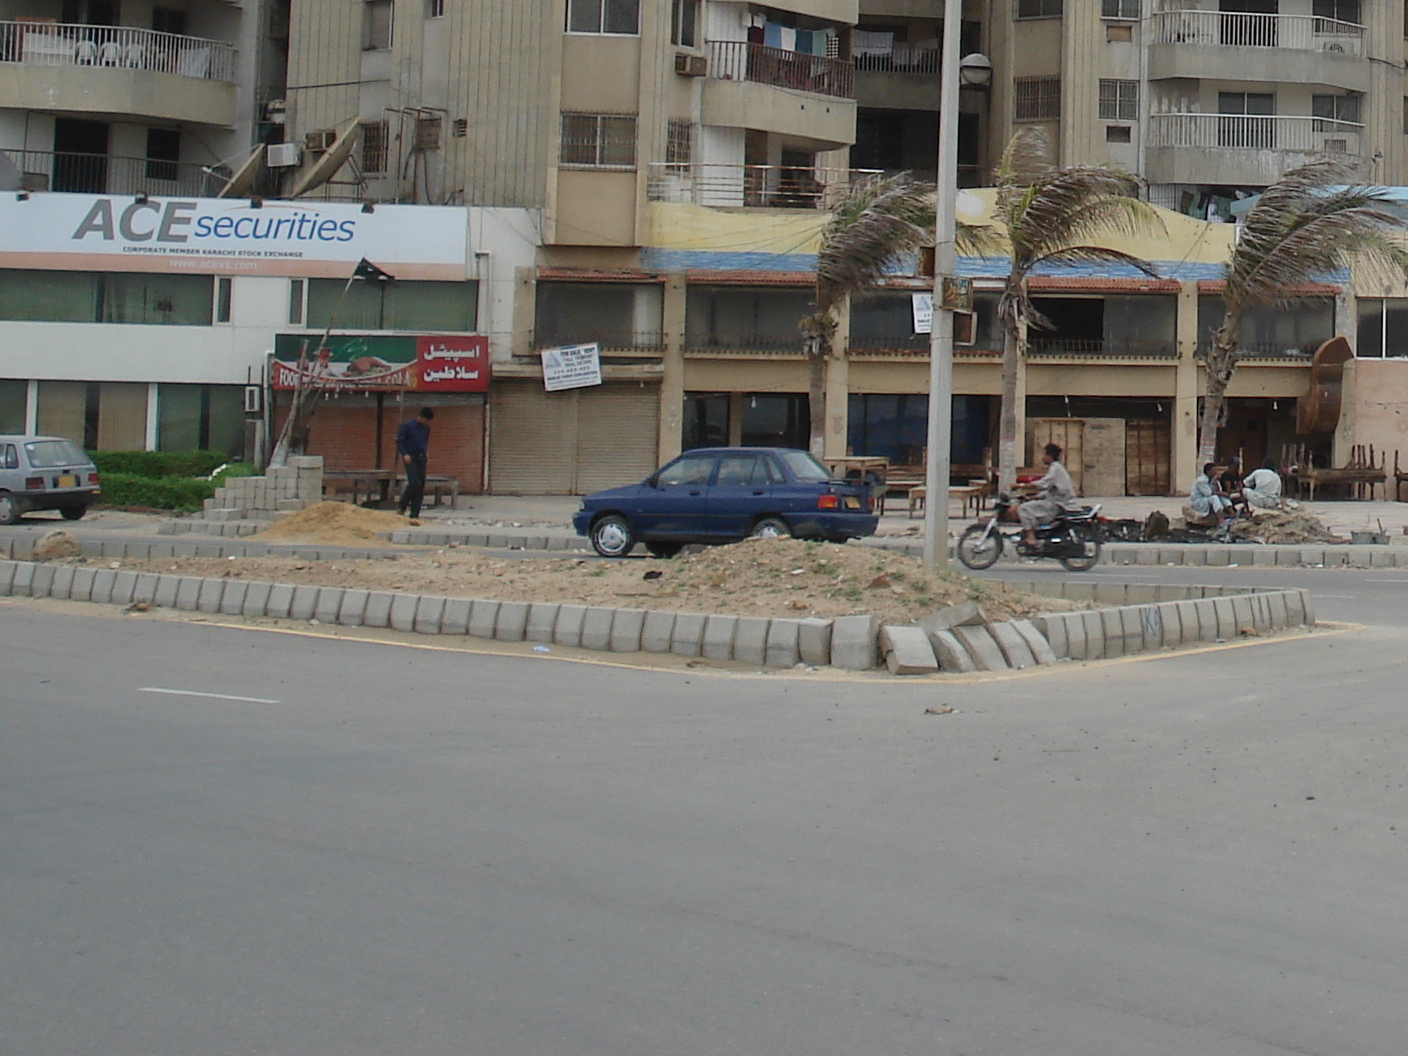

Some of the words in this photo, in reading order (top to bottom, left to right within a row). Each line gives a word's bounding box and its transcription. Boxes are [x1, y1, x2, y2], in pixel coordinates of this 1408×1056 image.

[71, 198, 198, 244] ACE
[194, 211, 356, 242] securities
[122, 246, 167, 254] CORPORATE
[169, 247, 200, 255] MEMBER
[202, 248, 236, 256] KARACHI
[264, 250, 304, 258] EXCHANGE
[279, 367, 300, 387] FOO
